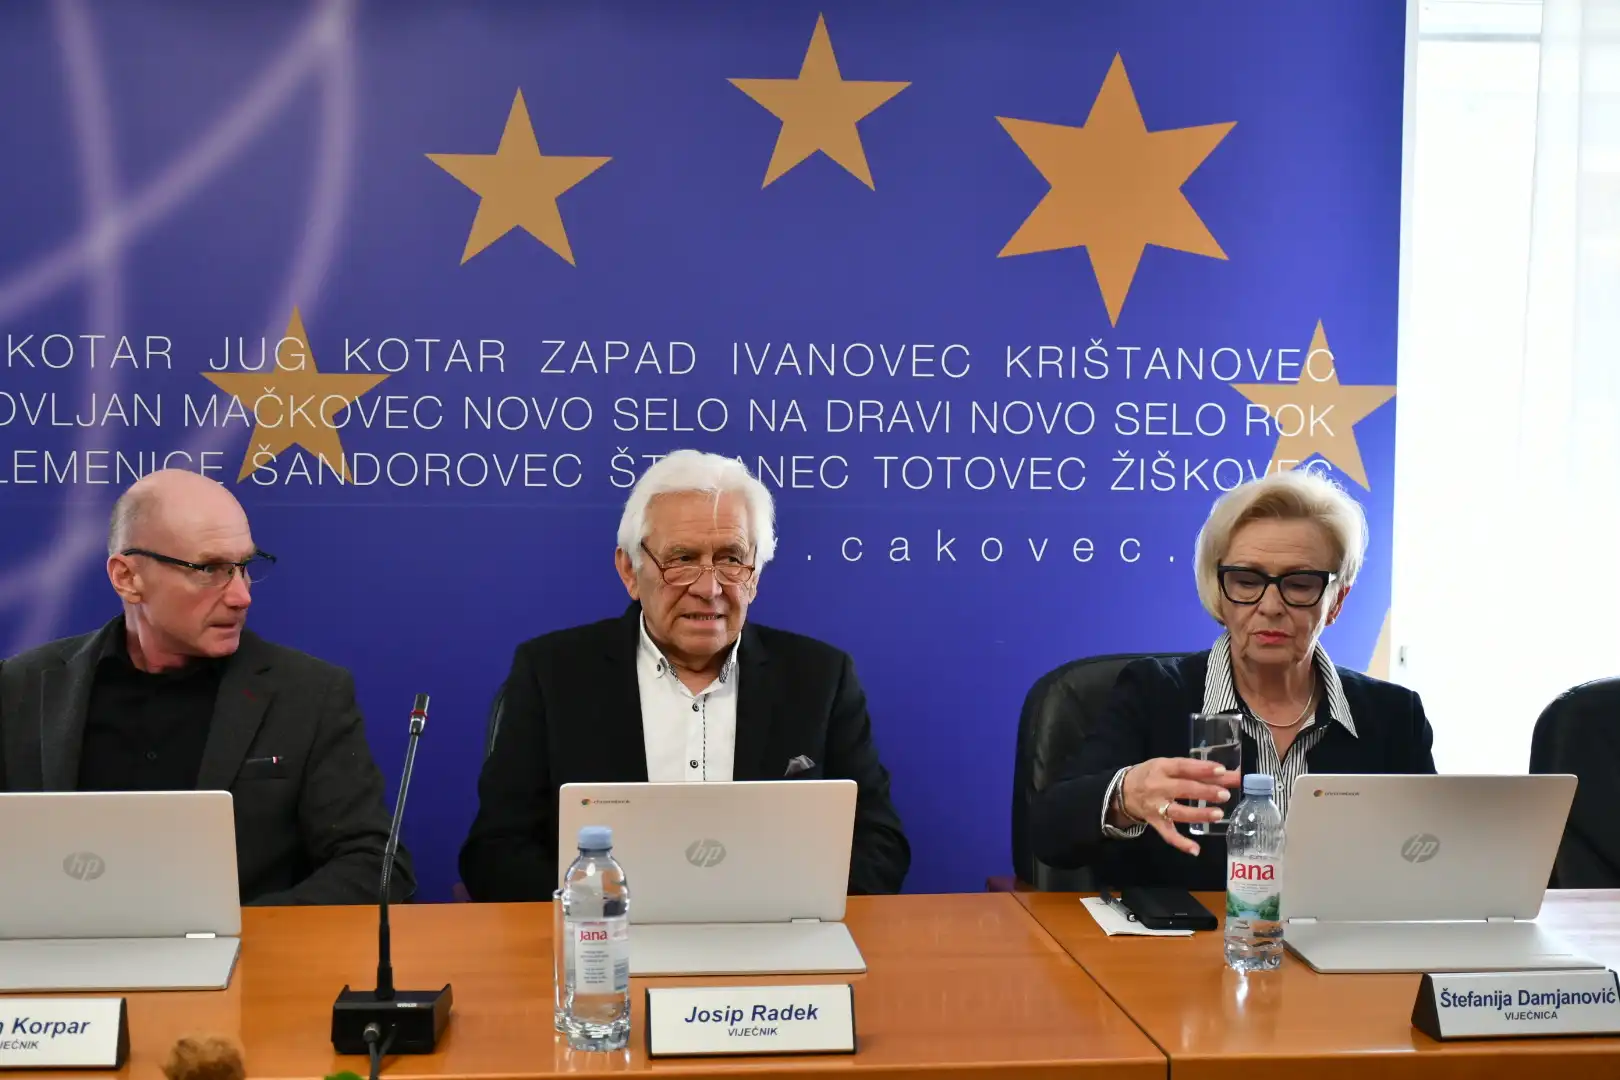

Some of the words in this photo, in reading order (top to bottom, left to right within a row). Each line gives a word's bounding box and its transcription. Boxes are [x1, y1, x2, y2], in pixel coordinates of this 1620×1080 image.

[7, 334, 173, 370] KOTAR
[209, 336, 306, 372] JUG
[345, 338, 506, 373] KOTAR
[540, 340, 696, 375] ZAPAD
[733, 342, 971, 377] IVANOVEC
[1006, 338, 1336, 383] KRIŠTANOVEC
[184, 386, 443, 429] MAČKOVEC
[464, 396, 593, 431] NOVO
[613, 398, 729, 432] SELO
[749, 399, 807, 432] NA
[827, 400, 950, 433] DRAVI
[971, 401, 1095, 436] NOVO
[1115, 402, 1226, 437] SELO
[1247, 403, 1335, 437] ROK
[251, 444, 582, 488] ŠANDOROVEC
[873, 456, 1086, 491] TOTOVEC
[688, 838, 723, 868] hp
[1403, 833, 1438, 863] hp
[67, 851, 102, 882] hp
[1230, 861, 1275, 881] Jana
[579, 930, 608, 942] Jana
[1440, 988, 1512, 1010] Štefanija
[1518, 988, 1616, 1009] Damjanović
[684, 1005, 744, 1026] Josip
[751, 1004, 819, 1022] Radek
[1504, 1010, 1558, 1021] VIJEČNICA
[11, 1017, 91, 1039] Korpar
[728, 1026, 779, 1037] VIJEČNIK
